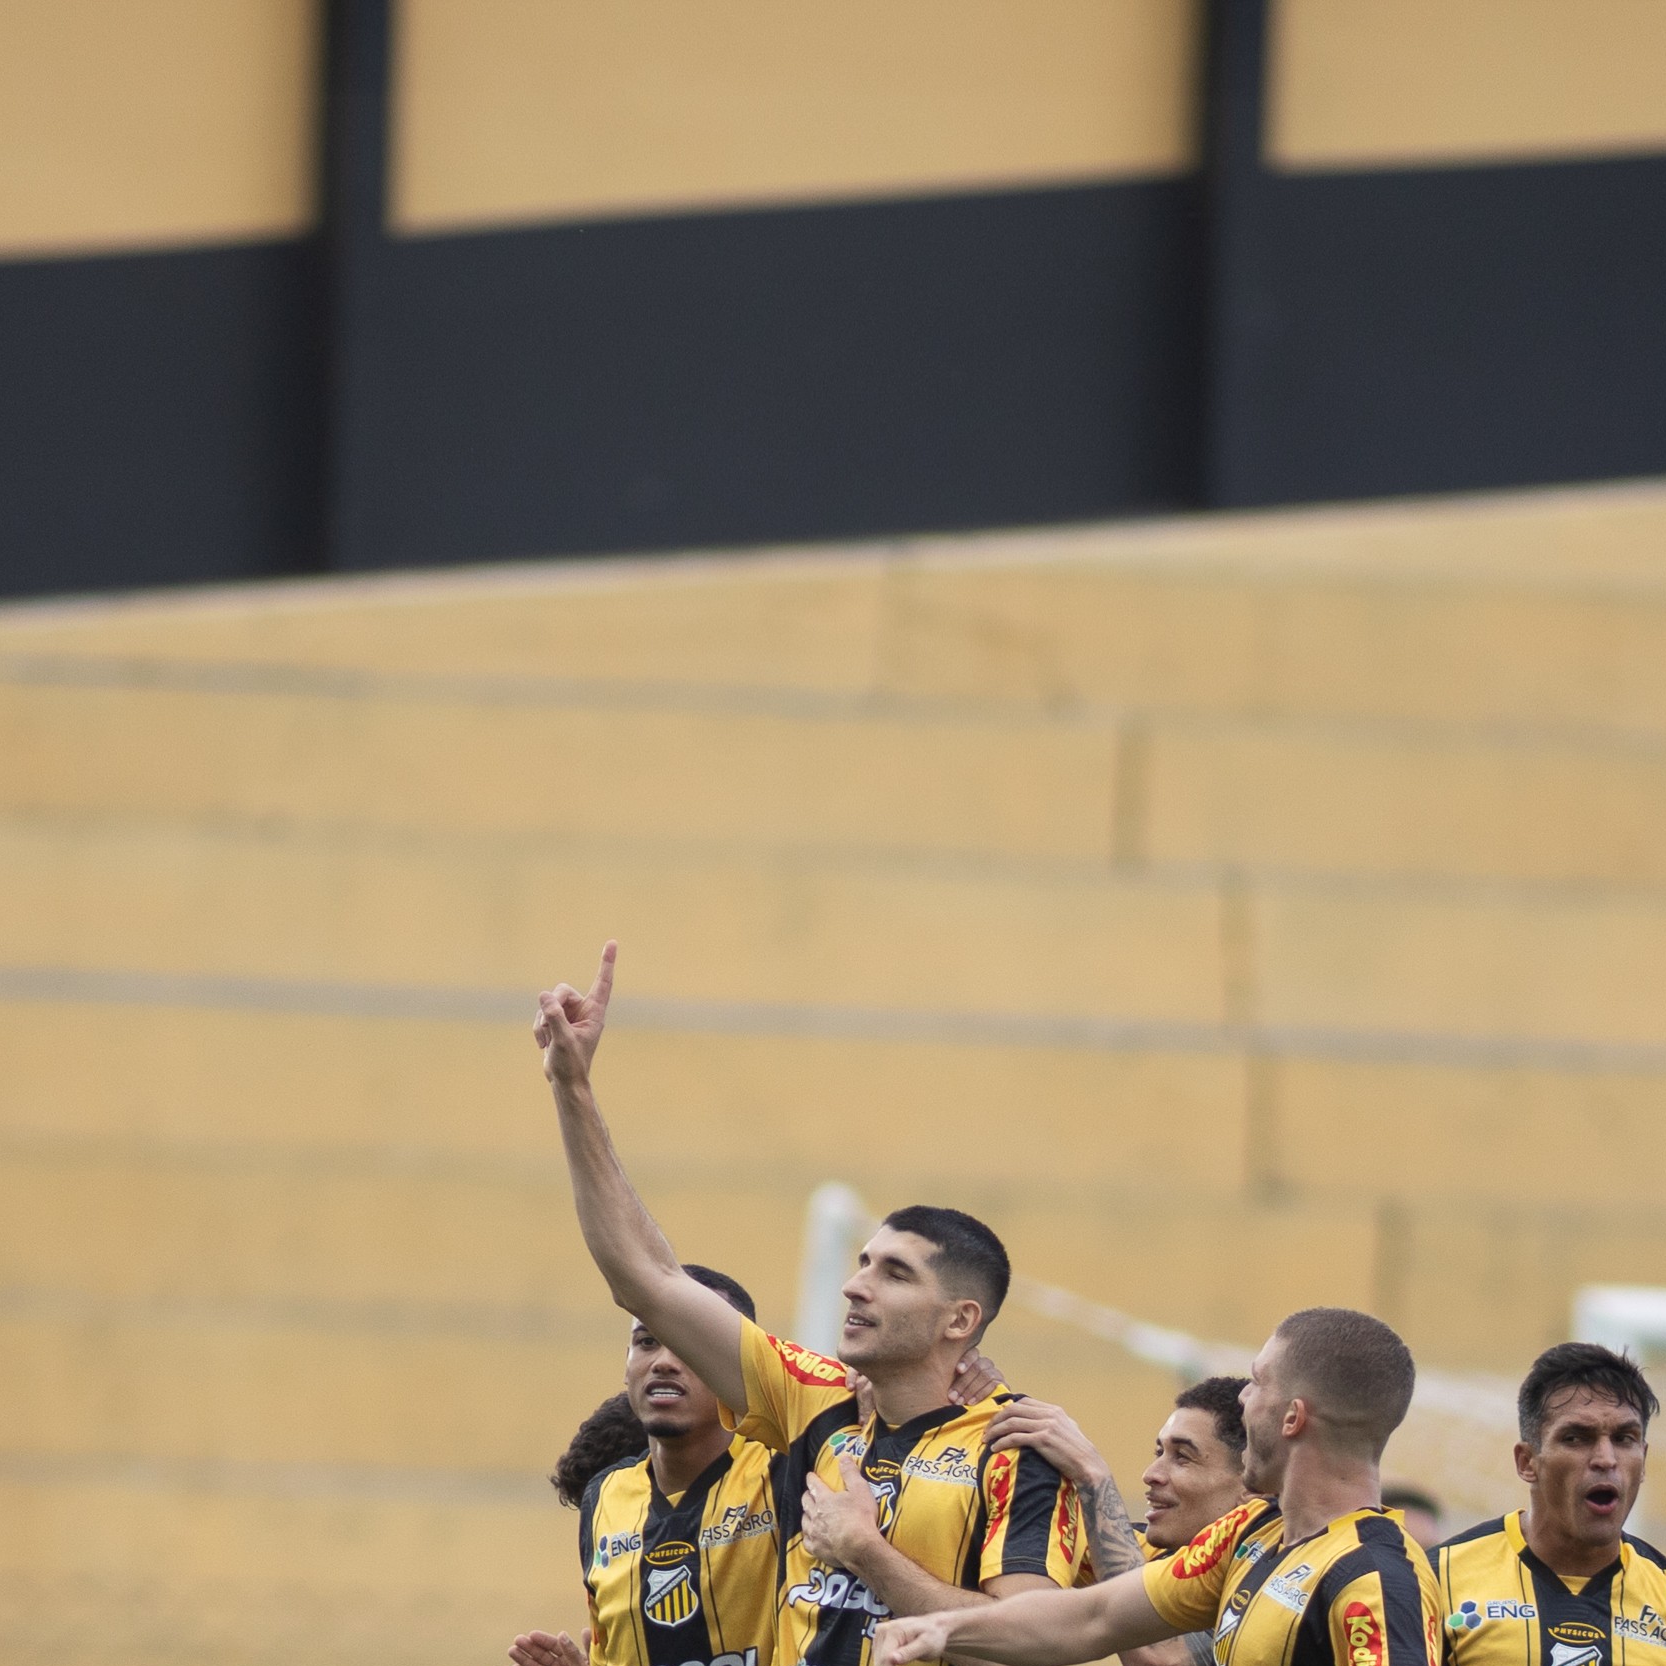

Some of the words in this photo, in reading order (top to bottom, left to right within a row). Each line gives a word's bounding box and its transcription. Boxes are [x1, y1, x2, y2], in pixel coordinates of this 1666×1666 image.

[612, 1534, 641, 1557] ENG
[1487, 1605, 1536, 1619] ENG
[1554, 1626, 1600, 1639] PHYSICUS
